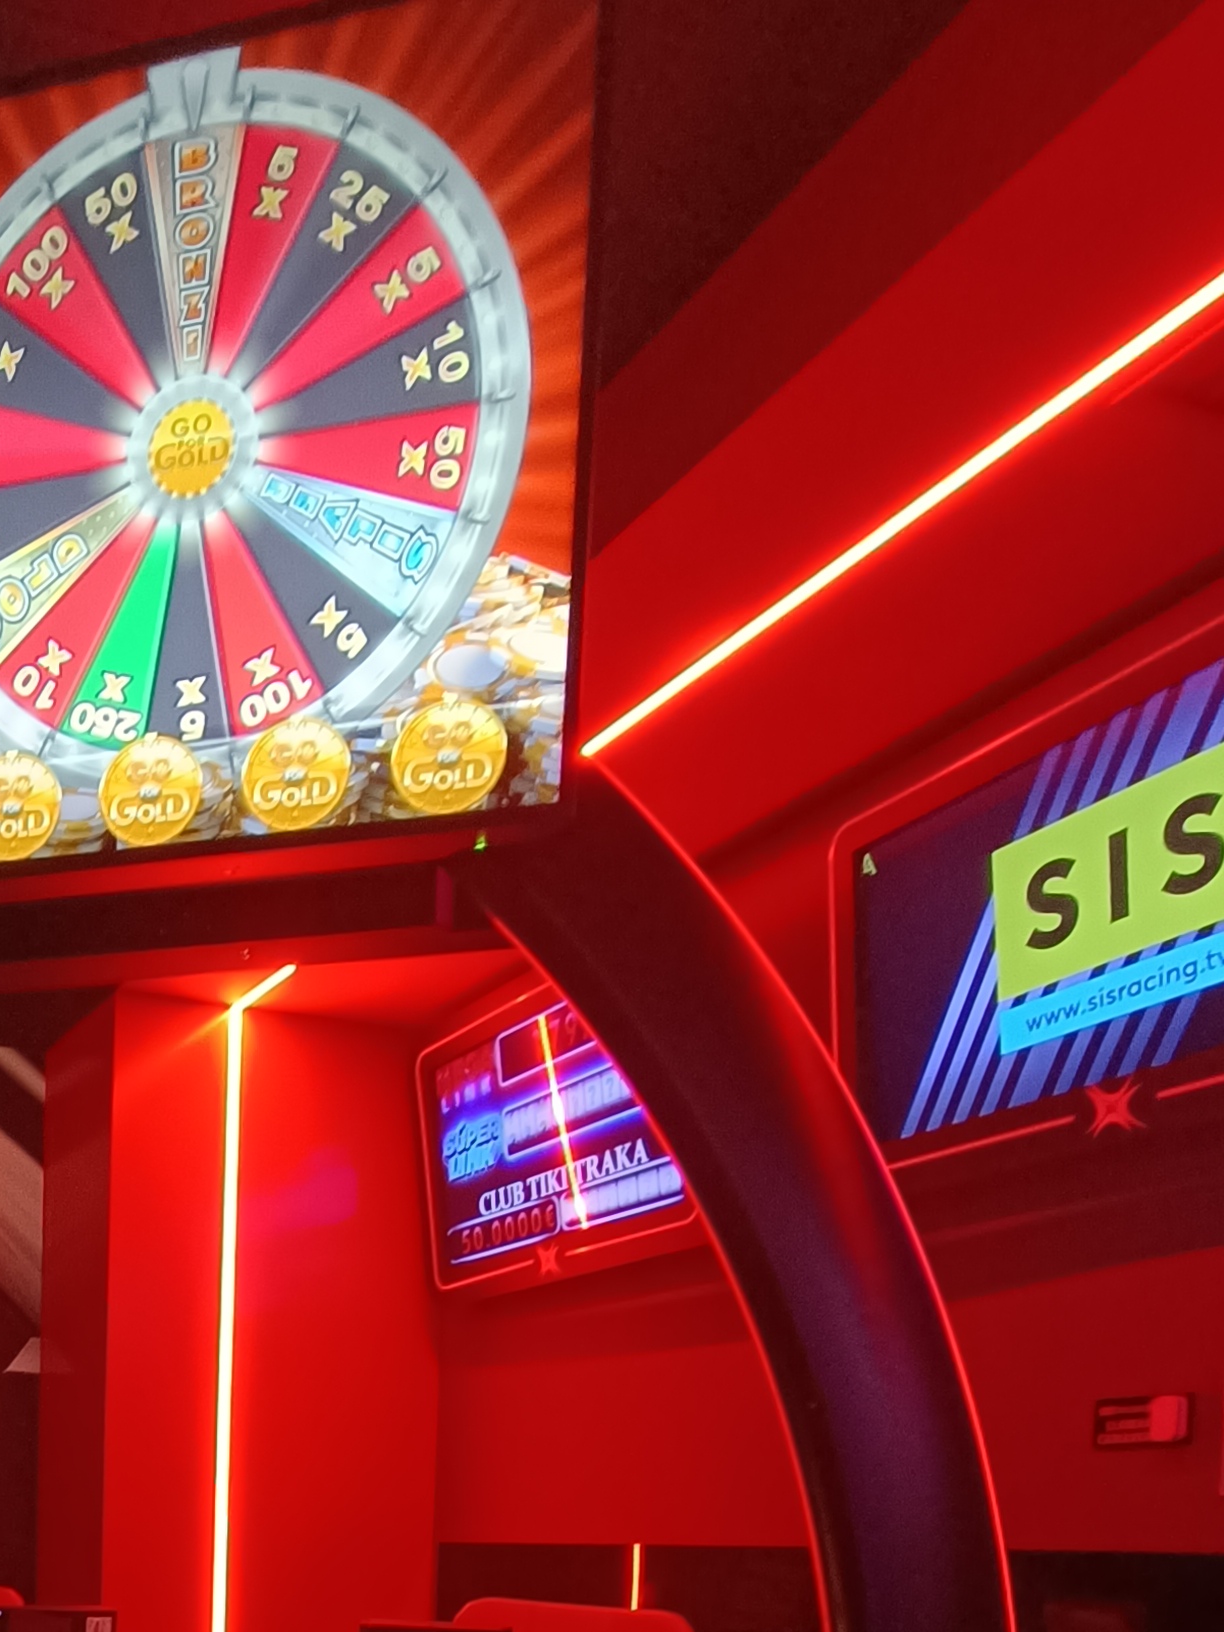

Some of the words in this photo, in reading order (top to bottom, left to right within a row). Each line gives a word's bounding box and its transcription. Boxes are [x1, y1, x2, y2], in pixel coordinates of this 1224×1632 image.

[266, 146, 298, 181] 5
[85, 172, 137, 225] 50
[329, 170, 391, 223] 25
[6, 225, 68, 299] 100
[405, 247, 440, 284] 5
[431, 320, 470, 384] 10
[170, 413, 212, 437] GO
[154, 437, 229, 471] GOLD
[429, 425, 465, 490] 50
[335, 621, 369, 659] 5
[13, 665, 55, 711] 10
[239, 674, 313, 727] 100
[179, 711, 205, 741] 5
[253, 771, 336, 810] GOLD
[403, 754, 492, 792] GOLD
[110, 789, 190, 825] GOLD
[1025, 792, 1224, 950] SIS
[1025, 948, 1224, 1033] www.sisracing.tv
[479, 1183, 524, 1216] CLUB
[526, 1170, 567, 1199] TIKI
[575, 1138, 649, 1184] TRAKA
